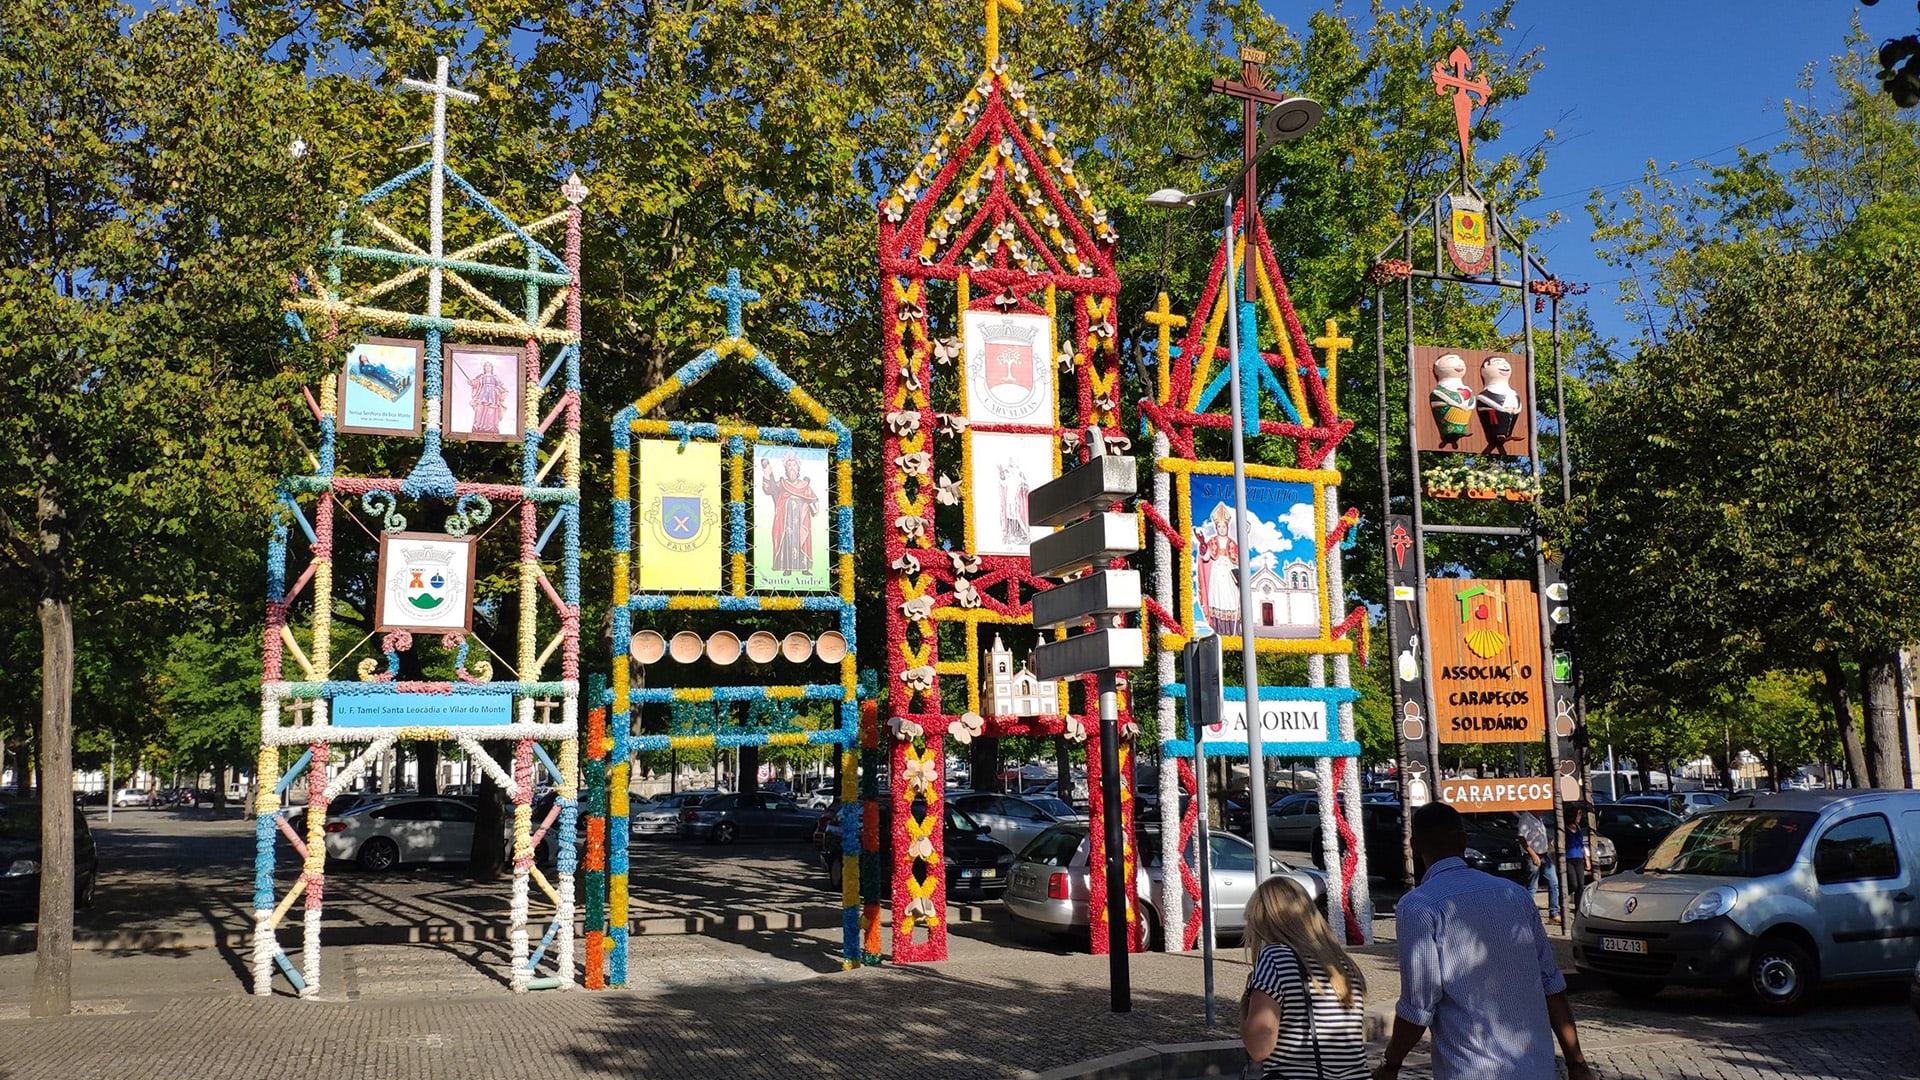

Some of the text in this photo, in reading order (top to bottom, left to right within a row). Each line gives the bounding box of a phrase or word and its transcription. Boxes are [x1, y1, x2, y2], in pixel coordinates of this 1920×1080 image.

[985, 398, 1037, 417] CARVALHAS
[1217, 484, 1299, 503] MTINHO
[667, 542, 697, 551] PALME
[761, 576, 824, 586] Santo André
[1441, 660, 1532, 682] ASSOCIAÇO
[1449, 690, 1529, 708] CARAPEÇOS
[338, 706, 347, 714] U.
[349, 706, 355, 714] F.
[358, 706, 380, 714] Tamel
[382, 706, 404, 714] Santa
[450, 705, 467, 713] Vilar
[469, 705, 479, 713] do
[481, 705, 506, 713] Monte
[1234, 711, 1319, 730] AORIM
[1451, 712, 1528, 731] SOLIDÁRIO
[1443, 783, 1551, 803] CARAPEÇOS
